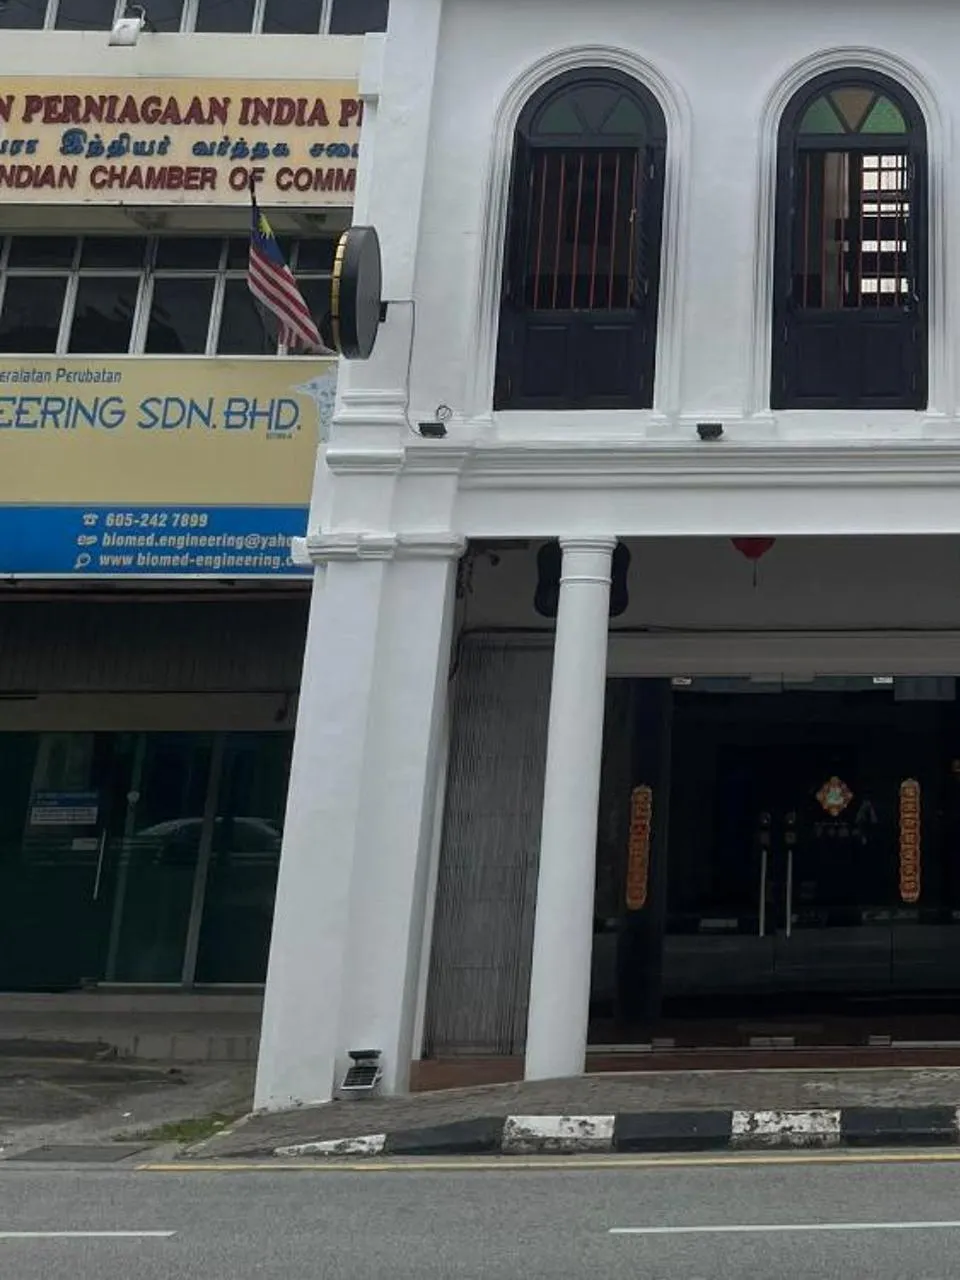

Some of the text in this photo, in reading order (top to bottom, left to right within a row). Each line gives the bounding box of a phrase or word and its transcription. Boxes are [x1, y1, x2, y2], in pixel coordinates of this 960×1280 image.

[22, 94, 231, 125] PERNIAGAAN
[238, 97, 330, 126] INDIA
[90, 165, 218, 191] CHAMBER
[229, 166, 265, 192] OF
[56, 368, 122, 384] Perubatan
[106, 513, 168, 527] 605-242
